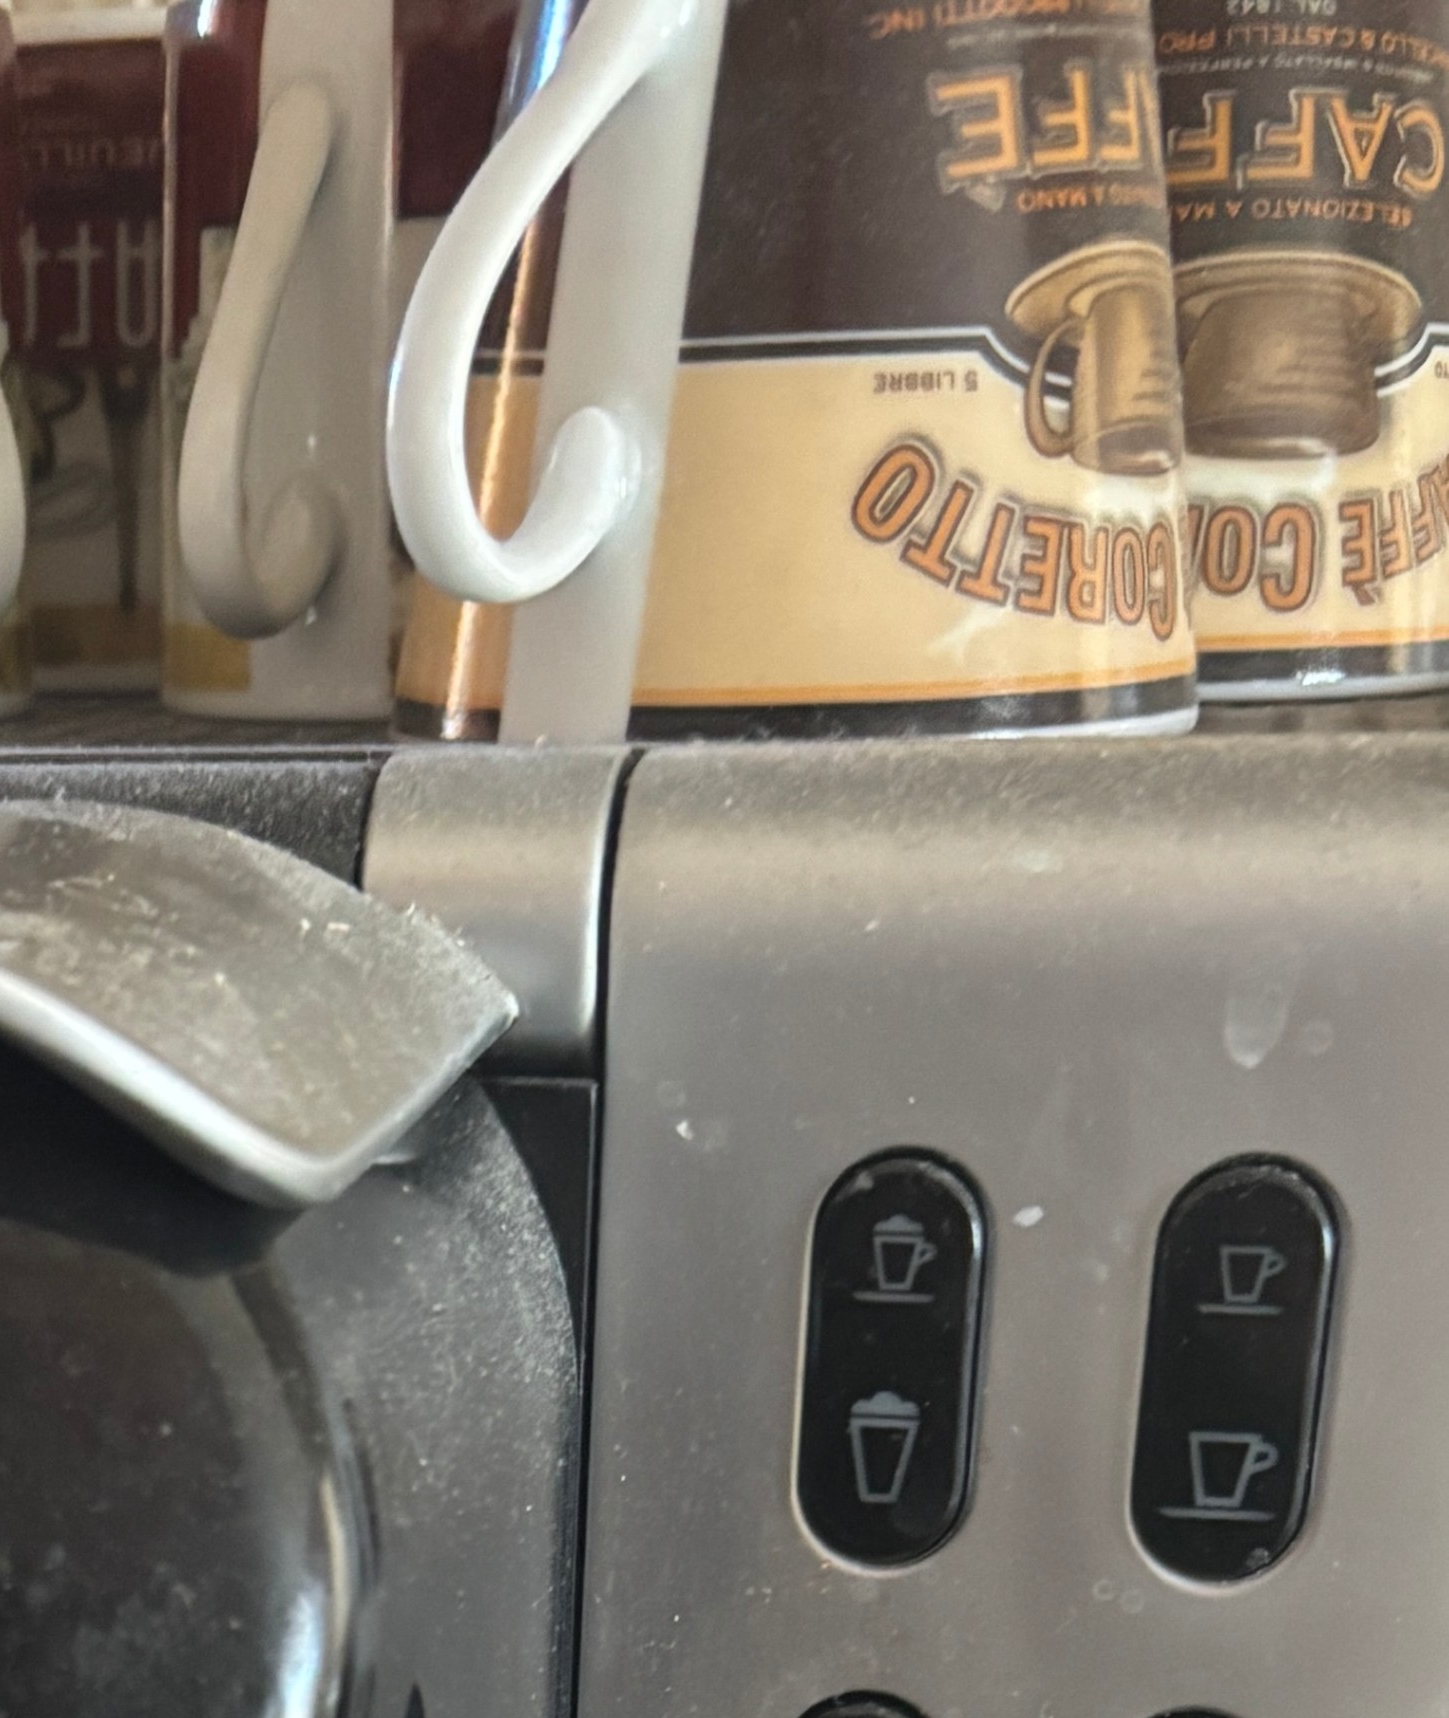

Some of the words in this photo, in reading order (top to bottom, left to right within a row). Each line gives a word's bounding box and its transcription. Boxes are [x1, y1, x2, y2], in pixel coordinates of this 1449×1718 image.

[1227, 22, 1355, 48] CASTELLI
[1166, 90, 1445, 196] CAFF
[1169, 199, 1216, 222] MA
[872, 370, 956, 394] LIBBRE
[964, 372, 979, 394] 5
[852, 442, 1179, 642] CORETTO
